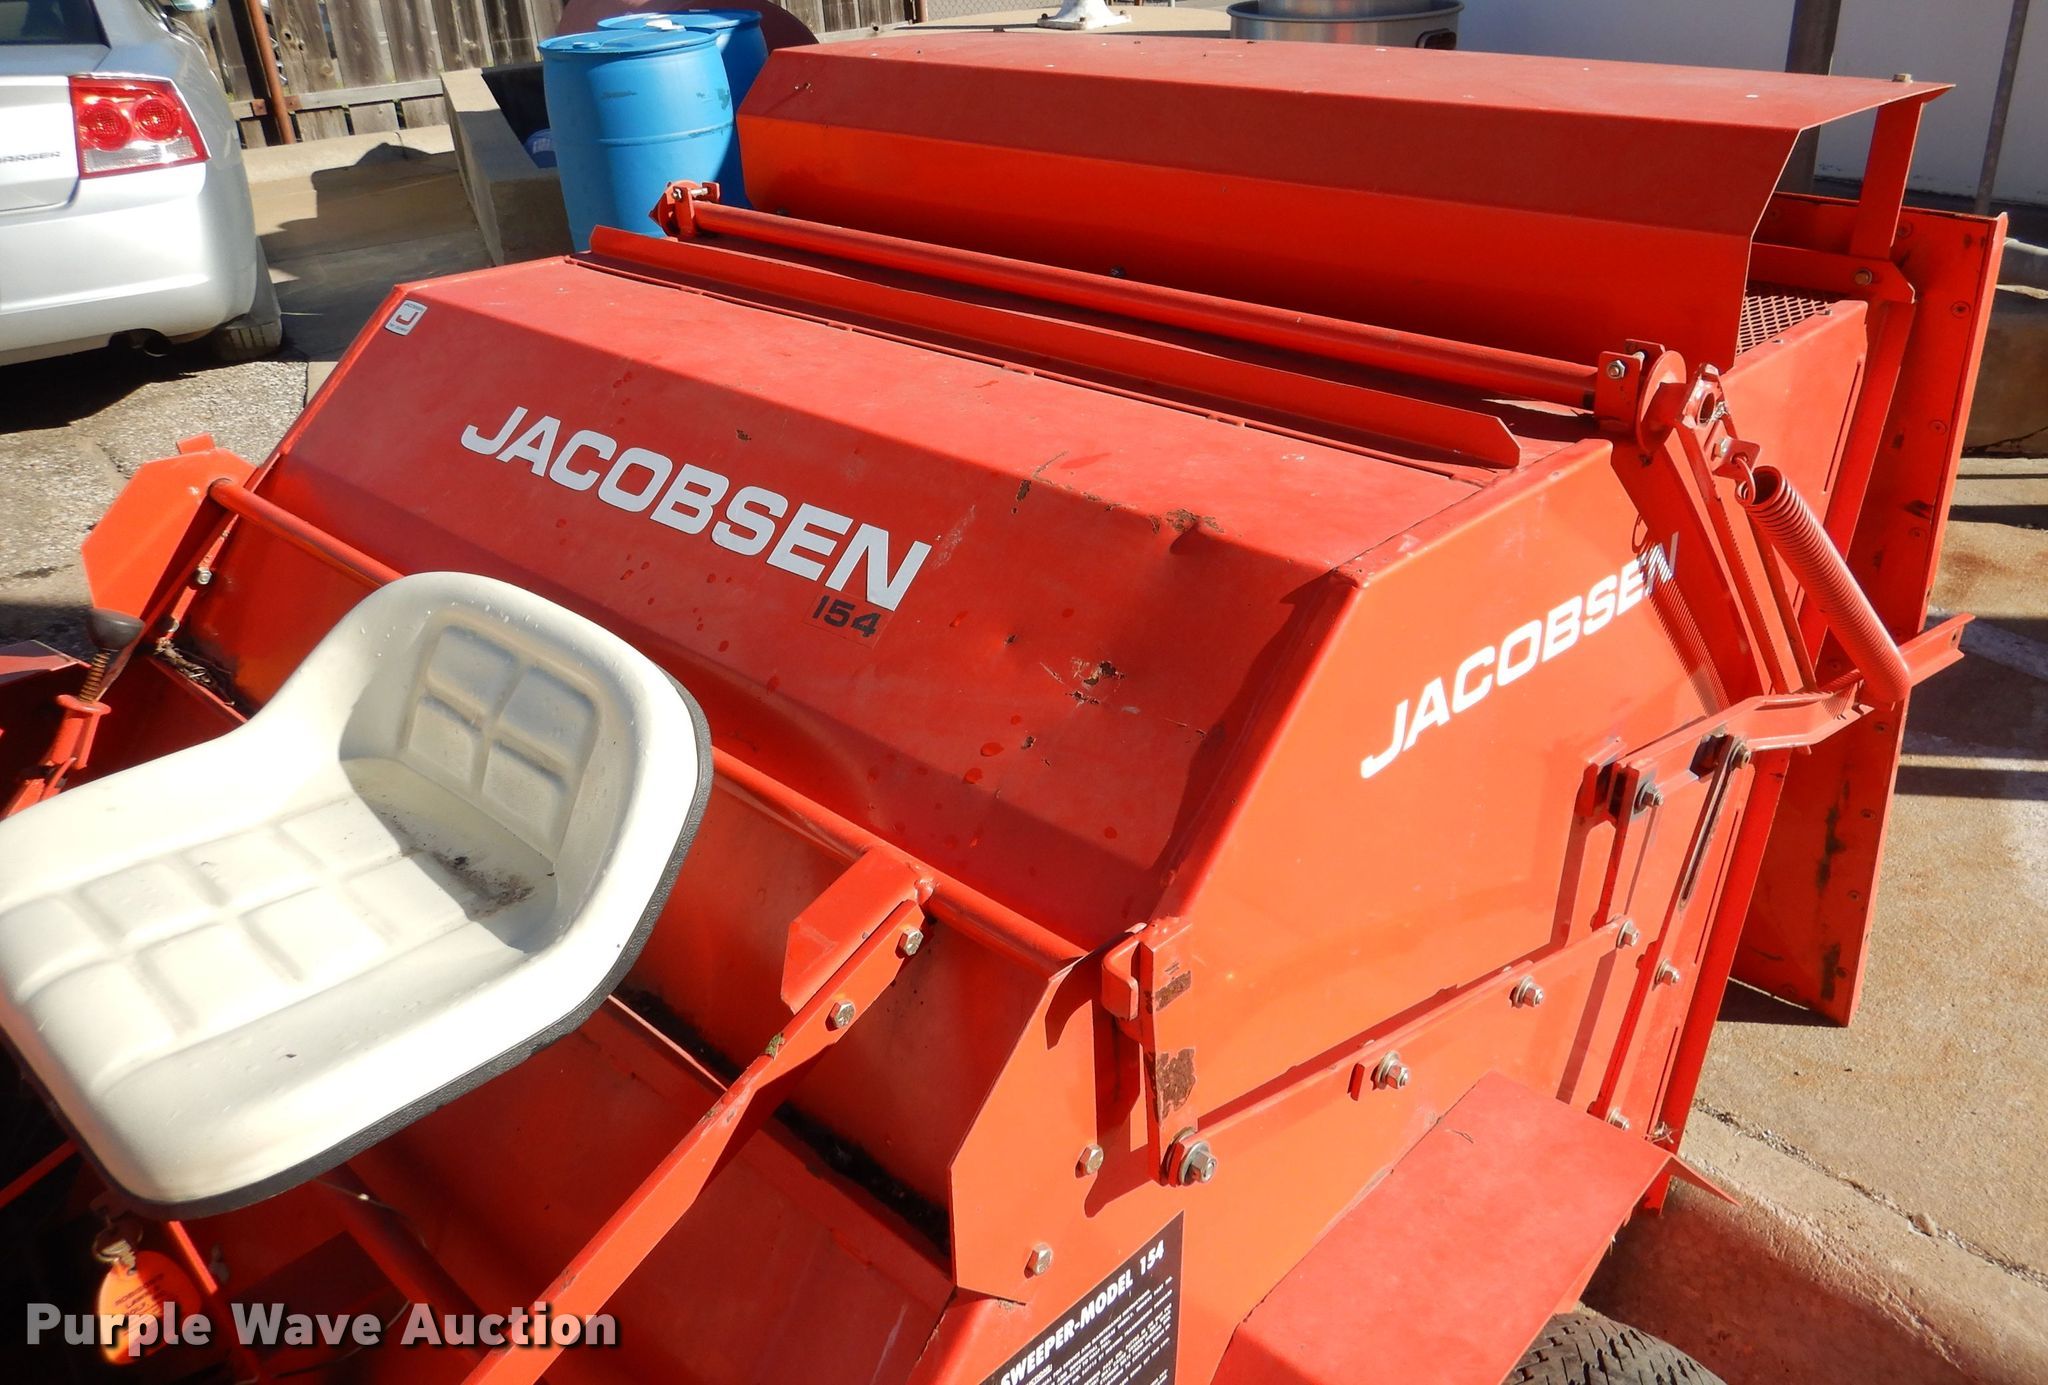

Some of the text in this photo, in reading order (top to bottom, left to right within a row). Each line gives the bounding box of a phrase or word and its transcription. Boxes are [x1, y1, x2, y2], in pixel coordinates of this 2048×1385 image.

[461, 406, 932, 611] JACOBSEN
[812, 595, 881, 638] 154
[1361, 531, 1679, 779] JACOBSEN
[1139, 1240, 1164, 1275] 154
